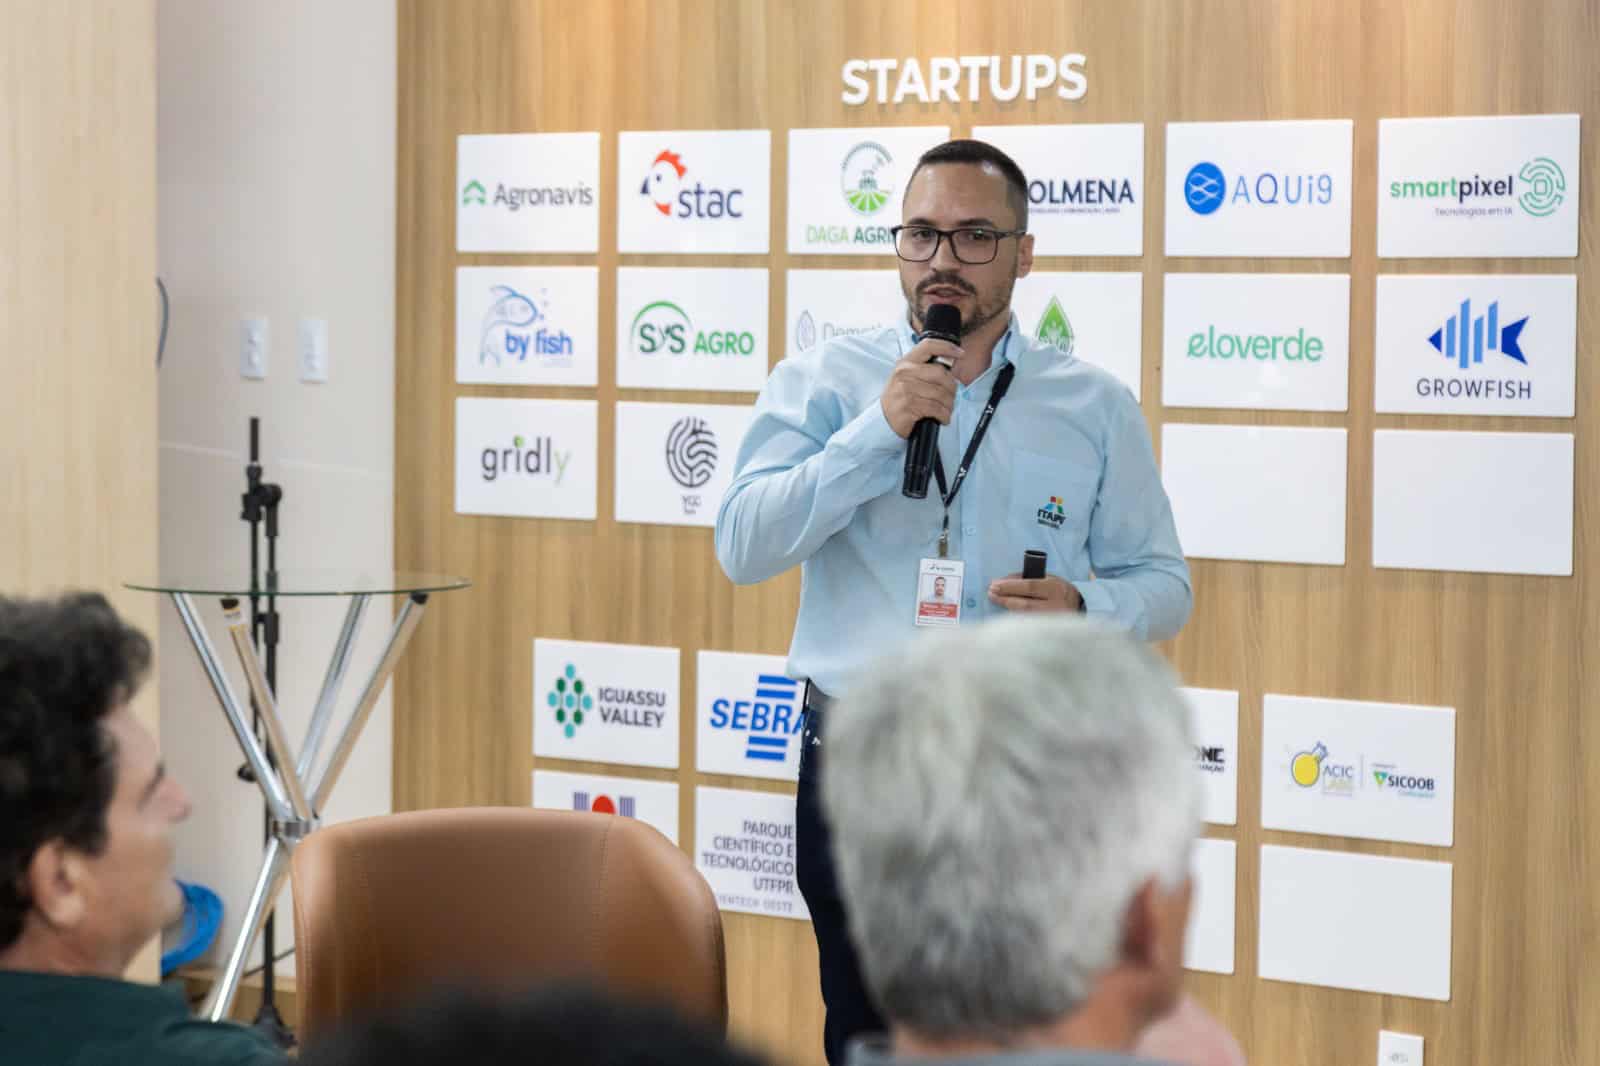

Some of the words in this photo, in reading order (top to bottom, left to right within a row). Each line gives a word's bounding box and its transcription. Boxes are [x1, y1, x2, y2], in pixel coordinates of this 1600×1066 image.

[841, 53, 1088, 104] STARTUPS
[494, 181, 593, 211] Agronavis
[677, 182, 743, 218] stac
[1027, 178, 1135, 204] OLMENA
[1390, 175, 1513, 204] smartpixel
[806, 224, 849, 244] DAGA
[853, 225, 896, 244] AGRI
[505, 328, 530, 361] by
[536, 327, 574, 355] fish
[693, 330, 755, 355] AGRO
[1187, 325, 1325, 362] eloverde
[1416, 377, 1532, 400] GROWFISH
[481, 434, 571, 483] gridly
[599, 687, 667, 708] IGUASSU
[600, 705, 665, 728] VALLEY
[1322, 764, 1354, 779] ACIC
[1388, 774, 1435, 791] SICOOB
[743, 820, 794, 839] PARQUE
[713, 835, 784, 857] CIENTÍFICO
[786, 841, 794, 859] E
[702, 852, 795, 876] TECNOLÓGICO
[753, 876, 794, 896] UTFPR
